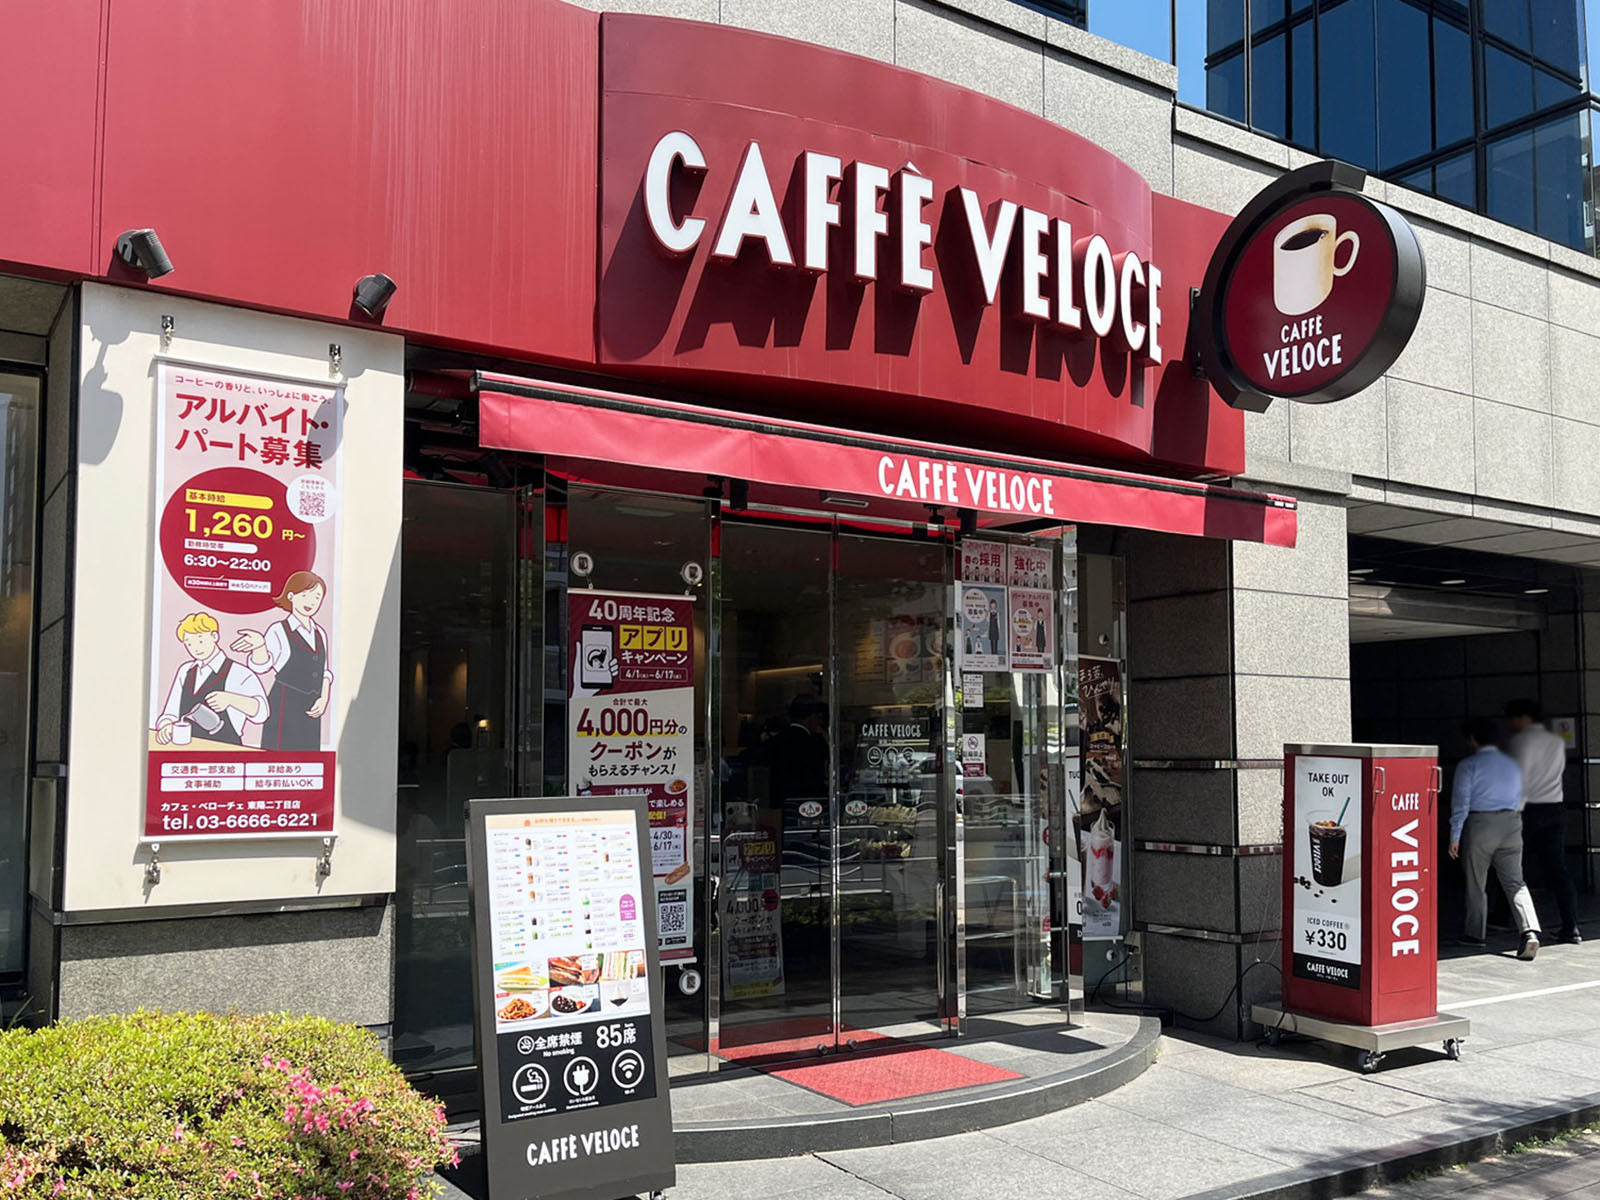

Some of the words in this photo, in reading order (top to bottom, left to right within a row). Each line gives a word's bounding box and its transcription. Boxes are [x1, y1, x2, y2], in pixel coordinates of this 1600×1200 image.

[962, 187, 1162, 366] VELOCE
[1263, 333, 1342, 380] VELOCE
[175, 428, 323, 470] パート募集
[964, 468, 1054, 515] VELOCE
[184, 508, 273, 539] 1,260
[965, 553, 1001, 568] 春の採用
[1015, 556, 1046, 573] 強化中
[589, 599, 676, 623] 40周年記念
[623, 626, 685, 648] アプリ
[621, 650, 688, 666] キャンペーン
[577, 708, 687, 737] 4,000円分の
[890, 724, 921, 738] VELOCE
[590, 741, 677, 761] クーポンが
[170, 765, 236, 775] 交通費一部支給
[267, 764, 302, 774] 昇給あり
[184, 779, 222, 788] 食事補助
[254, 778, 314, 788] 給与前払いOK
[1308, 772, 1330, 784] TAKE
[1331, 773, 1349, 785] OUT
[1322, 786, 1335, 798] OK
[160, 801, 245, 812] カフェ・ベローチェ
[1391, 818, 1420, 958] VELOCE
[1307, 917, 1321, 925] ICED
[1322, 919, 1344, 929] COFFEE
[1305, 928, 1347, 951] ¥330
[1326, 965, 1349, 979] VELOCE
[535, 1031, 583, 1050] 全席禁煙
[596, 1023, 637, 1049] 85席
[580, 1124, 640, 1156] VELOCE
